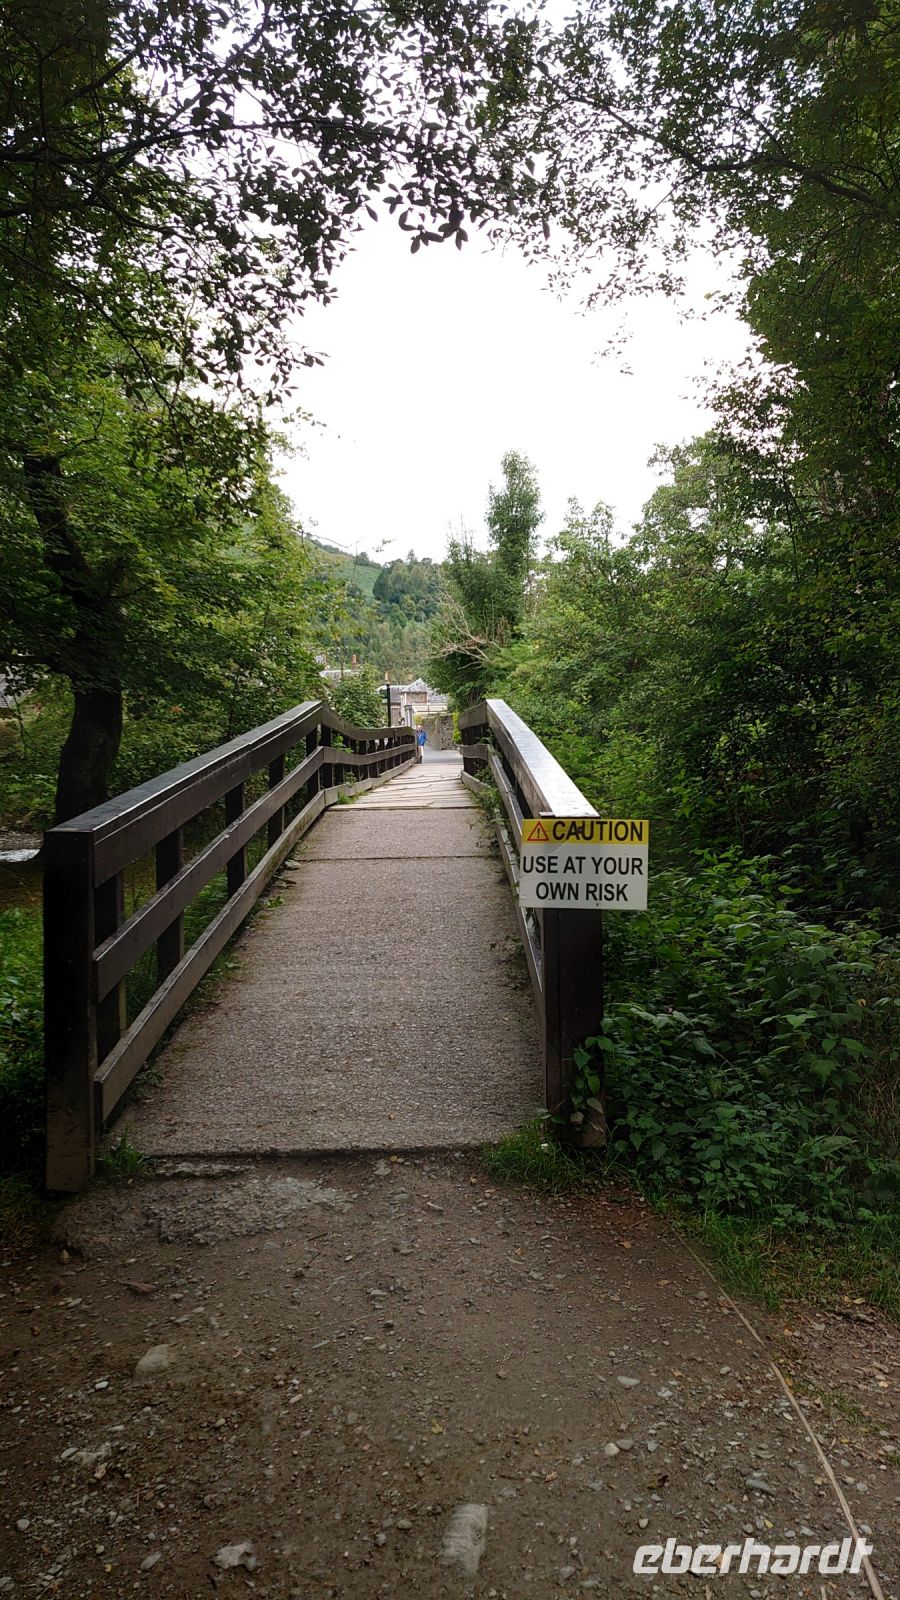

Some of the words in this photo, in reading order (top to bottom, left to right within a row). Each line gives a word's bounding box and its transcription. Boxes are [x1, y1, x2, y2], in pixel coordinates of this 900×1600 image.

[552, 820, 643, 842] CAUTION
[523, 856, 559, 874] USE
[563, 856, 586, 874] AT
[591, 857, 643, 875] YOUR
[536, 882, 579, 901] OWN
[586, 883, 629, 902] RISK
